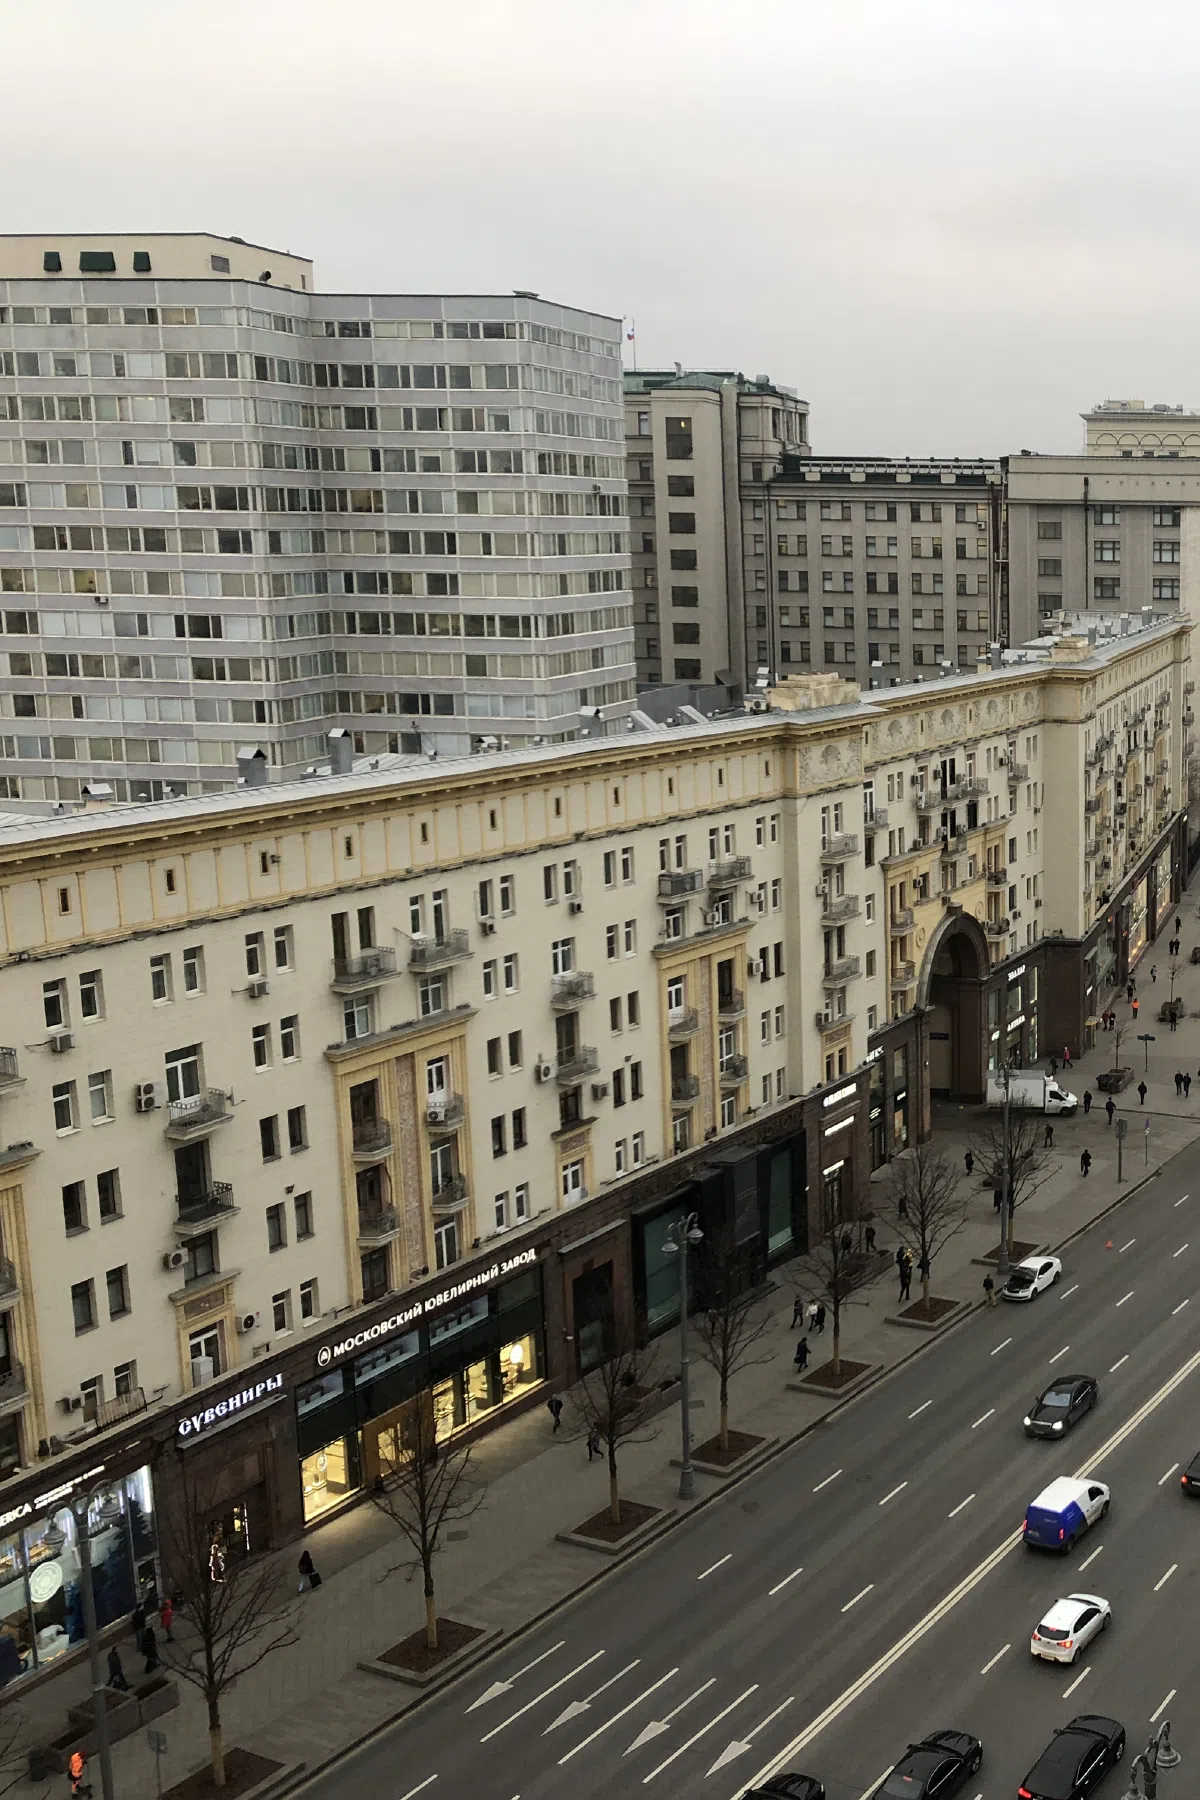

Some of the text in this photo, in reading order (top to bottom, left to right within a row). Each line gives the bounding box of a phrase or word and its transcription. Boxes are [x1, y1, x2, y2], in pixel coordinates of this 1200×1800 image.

[333, 1248, 536, 1357] МОСКОВСКИЙ ЮВЕЛИРНЫЙ ЗАВОД
[179, 1373, 283, 1436] СУВЕНИРЫ
